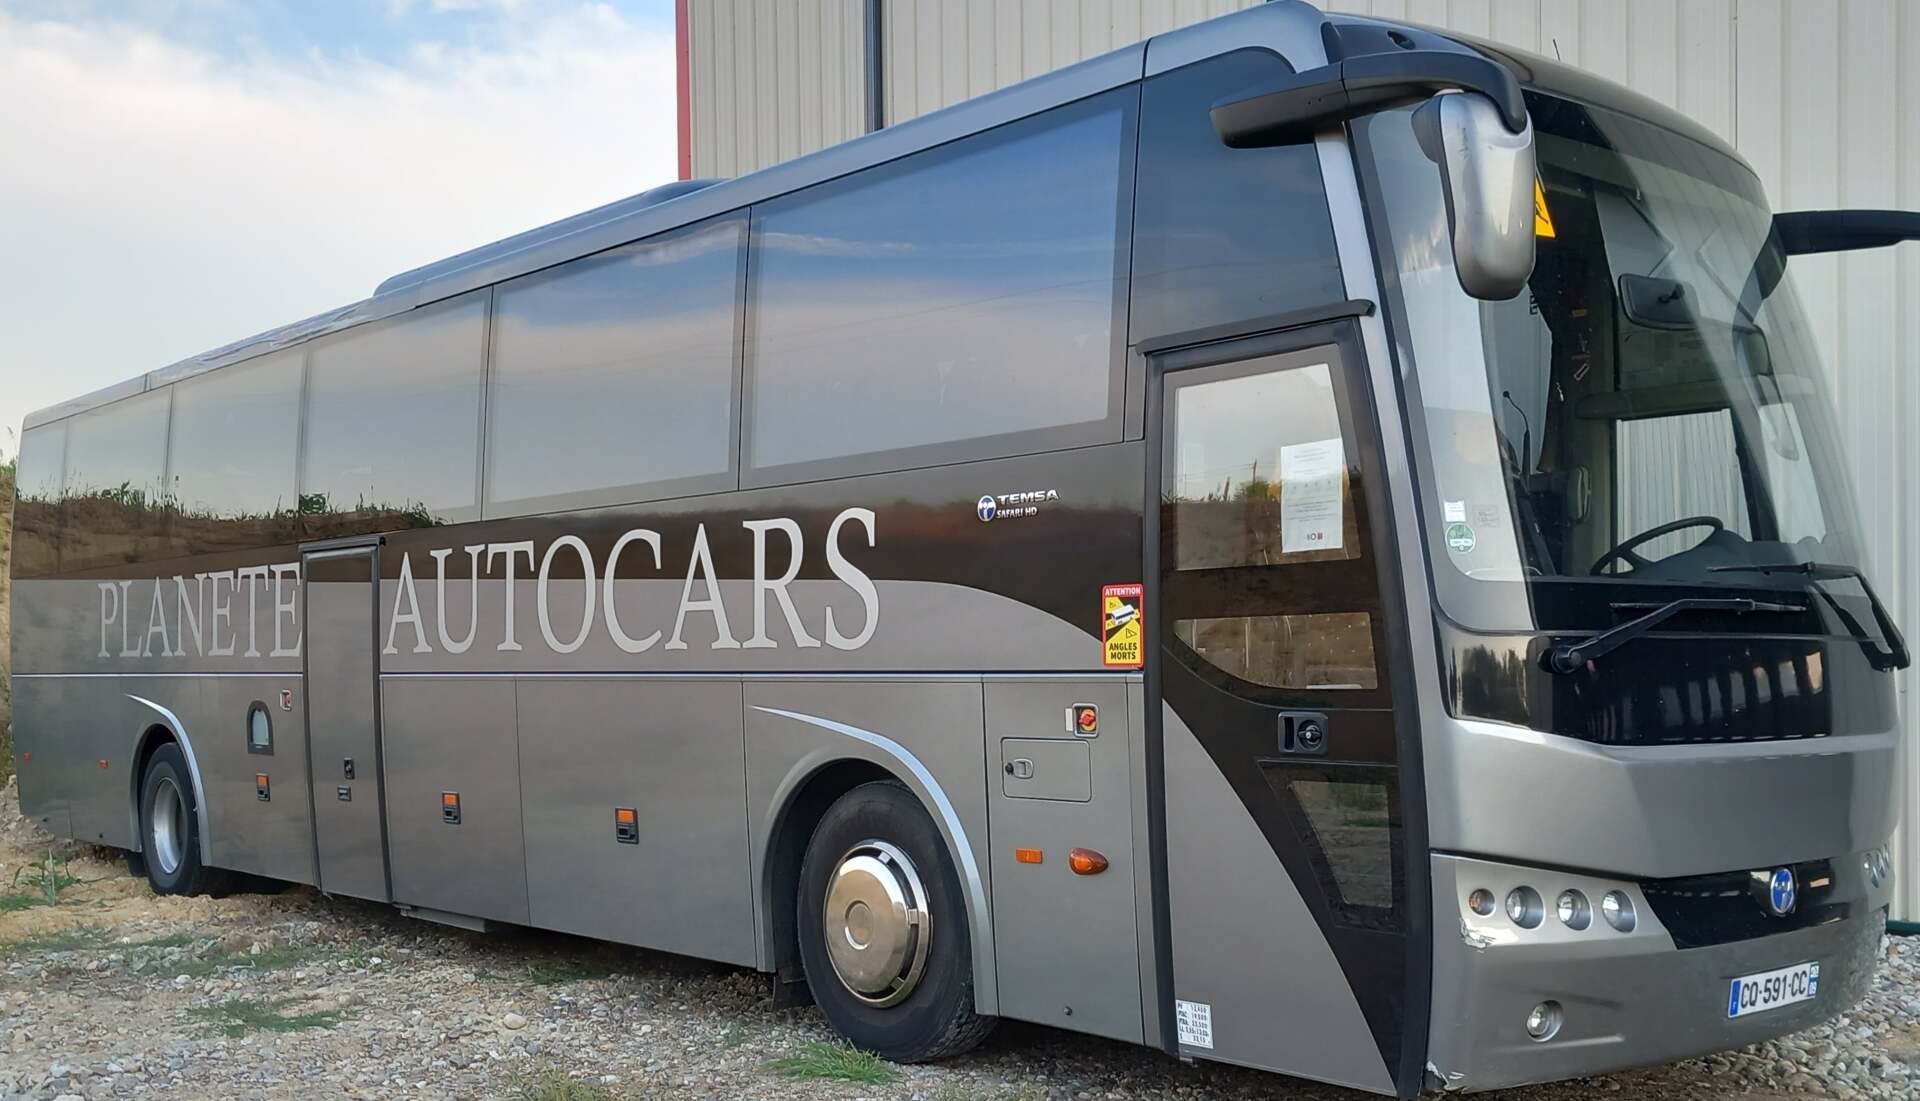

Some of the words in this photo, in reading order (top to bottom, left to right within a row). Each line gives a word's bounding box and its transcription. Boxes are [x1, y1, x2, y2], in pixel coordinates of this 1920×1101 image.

[997, 489, 1059, 505] TEMSA
[996, 507, 1023, 519] SAFARI
[1025, 506, 1038, 517] HD
[98, 562, 303, 657] PLANETE
[382, 507, 879, 654] AUTOCARS
[1105, 587, 1141, 596] ATTENTION
[1109, 642, 1137, 651] ANGLES
[1110, 651, 1136, 660] MORTS
